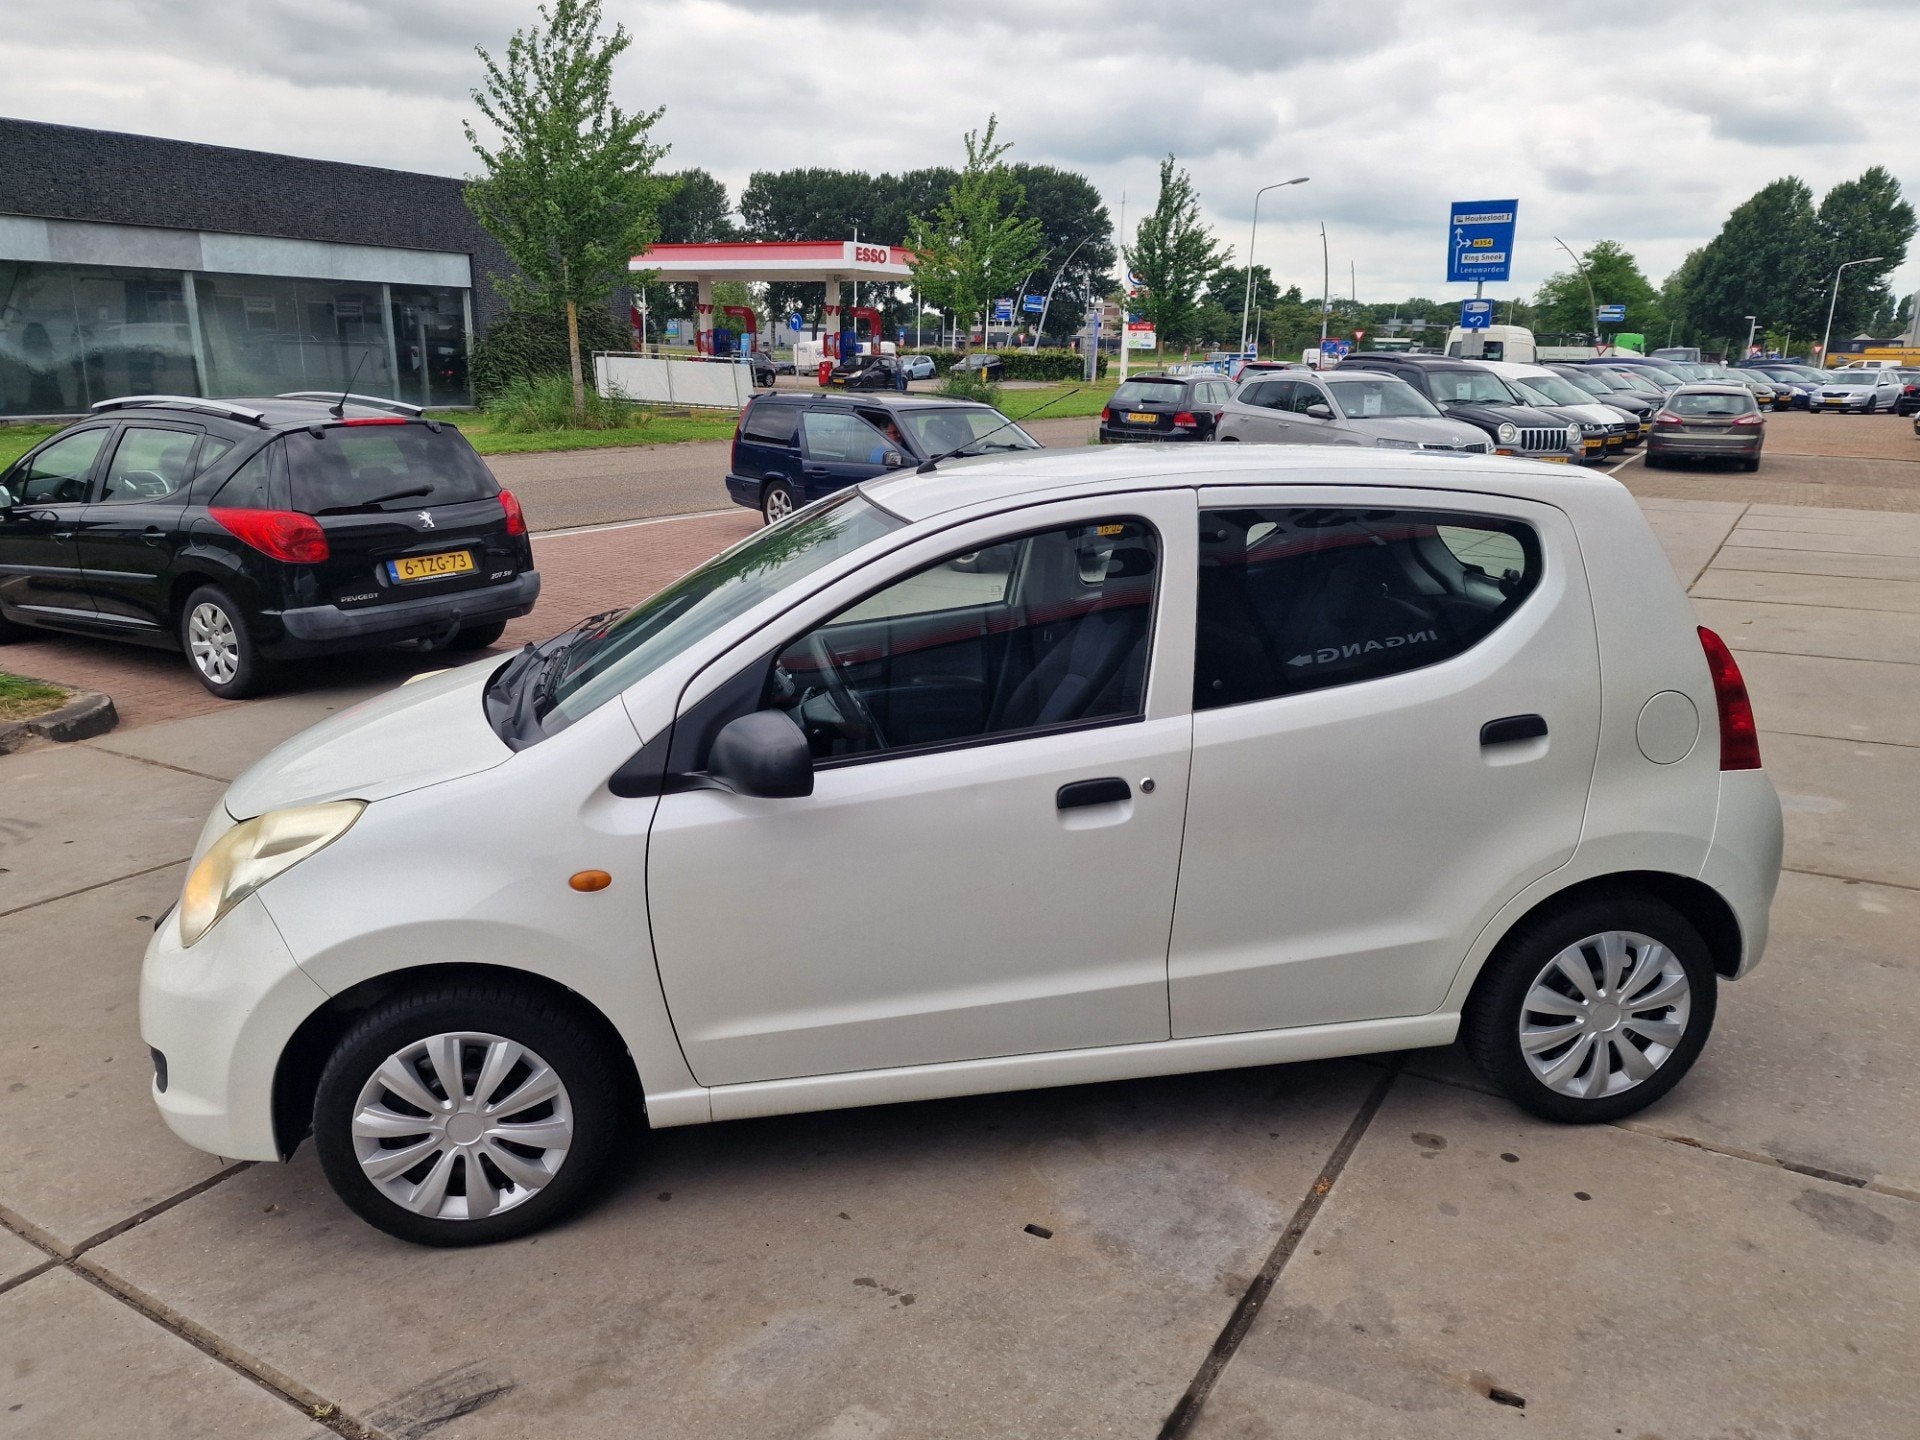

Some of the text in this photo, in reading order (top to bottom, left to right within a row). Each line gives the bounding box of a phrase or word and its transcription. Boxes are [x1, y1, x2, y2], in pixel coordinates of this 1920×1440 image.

[856, 246, 887, 264] ESSO
[1464, 254, 1479, 262] Ring
[404, 553, 467, 576] 6-TZG-73
[340, 592, 379, 603] PEUGEOT
